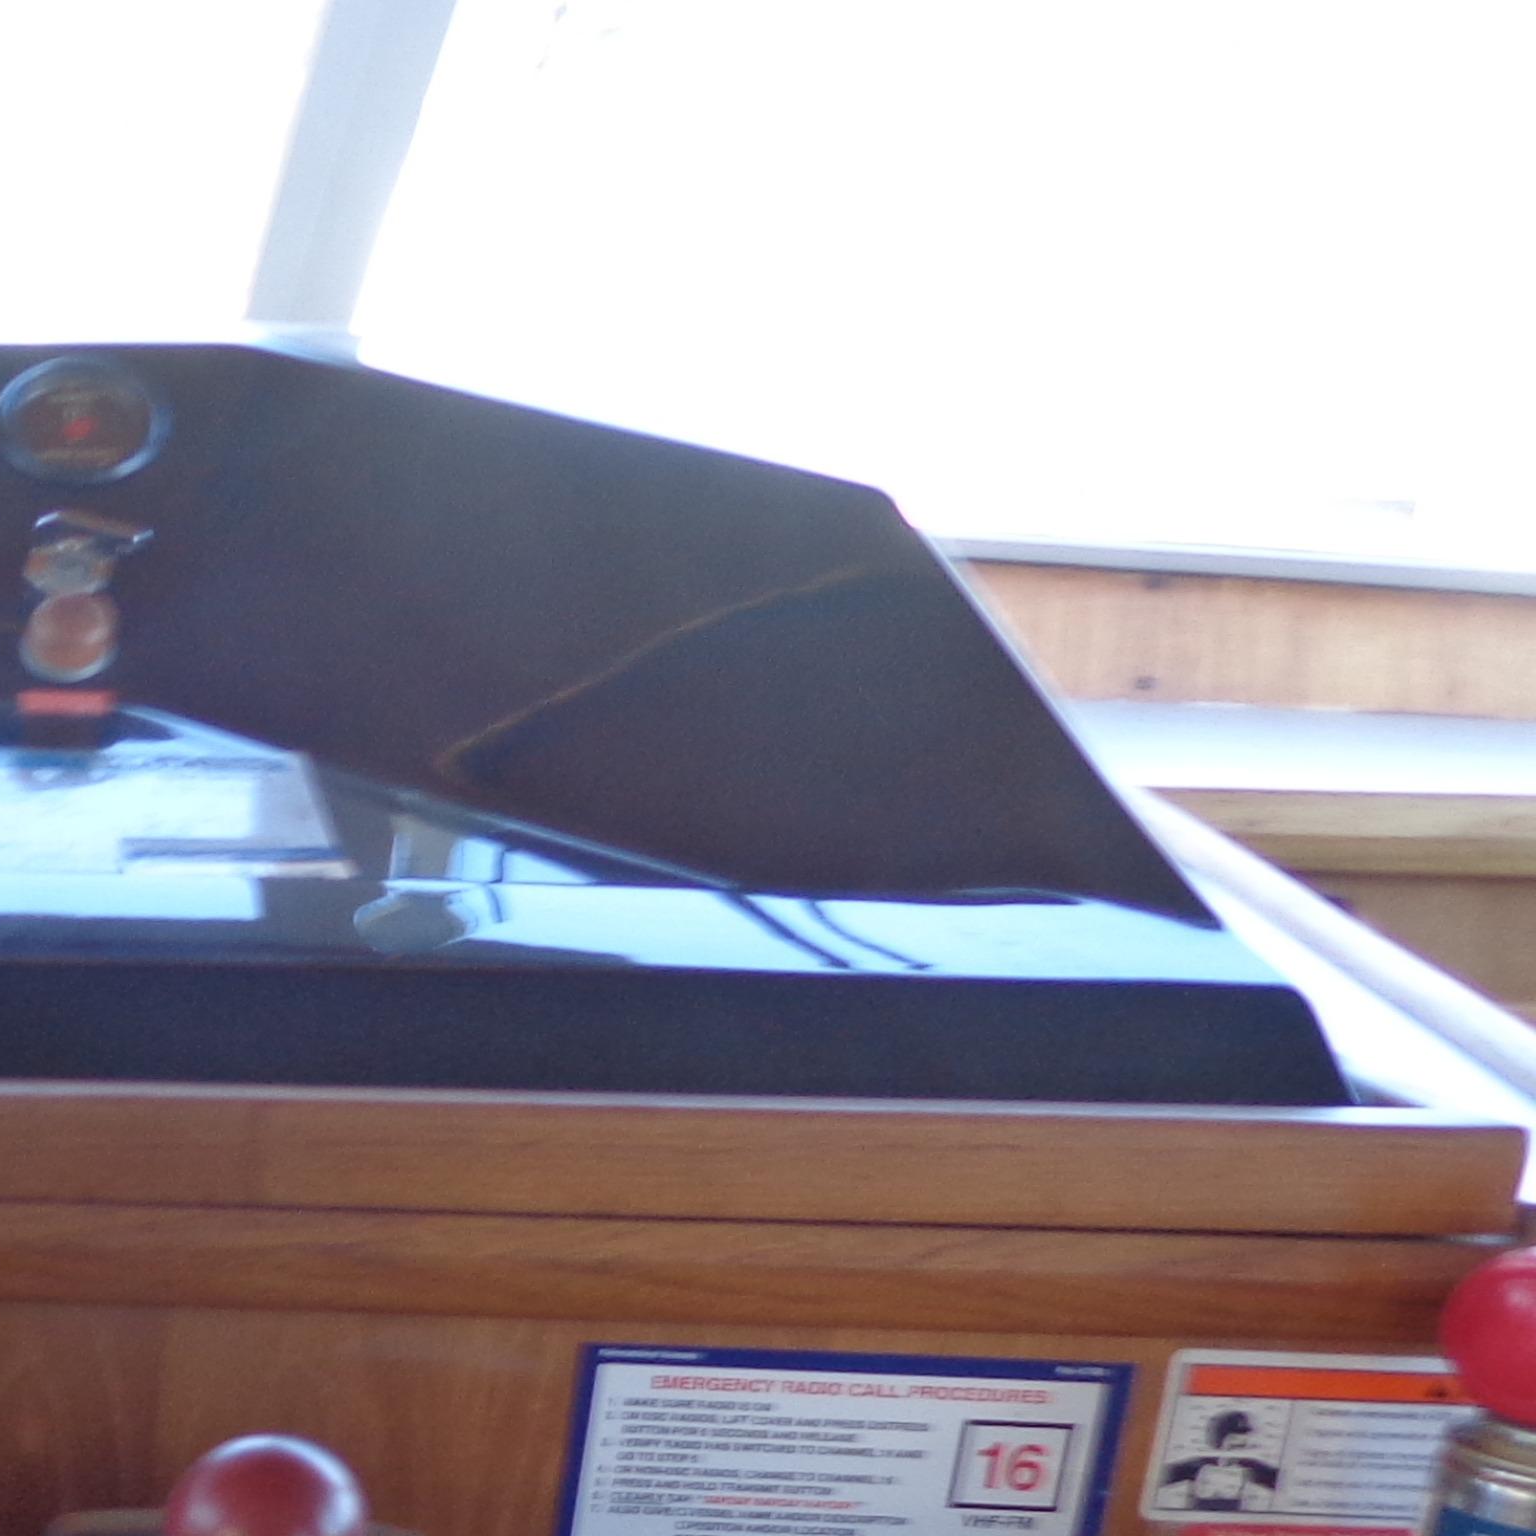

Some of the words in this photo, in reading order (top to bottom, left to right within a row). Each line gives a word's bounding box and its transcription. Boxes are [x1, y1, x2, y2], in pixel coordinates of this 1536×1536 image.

[650, 1375, 775, 1393] EMERGENCY
[781, 1379, 842, 1396] RADIO
[848, 1383, 899, 1399] CALL
[906, 1385, 1048, 1404] PROCEDURES
[977, 1441, 1046, 1491] 16
